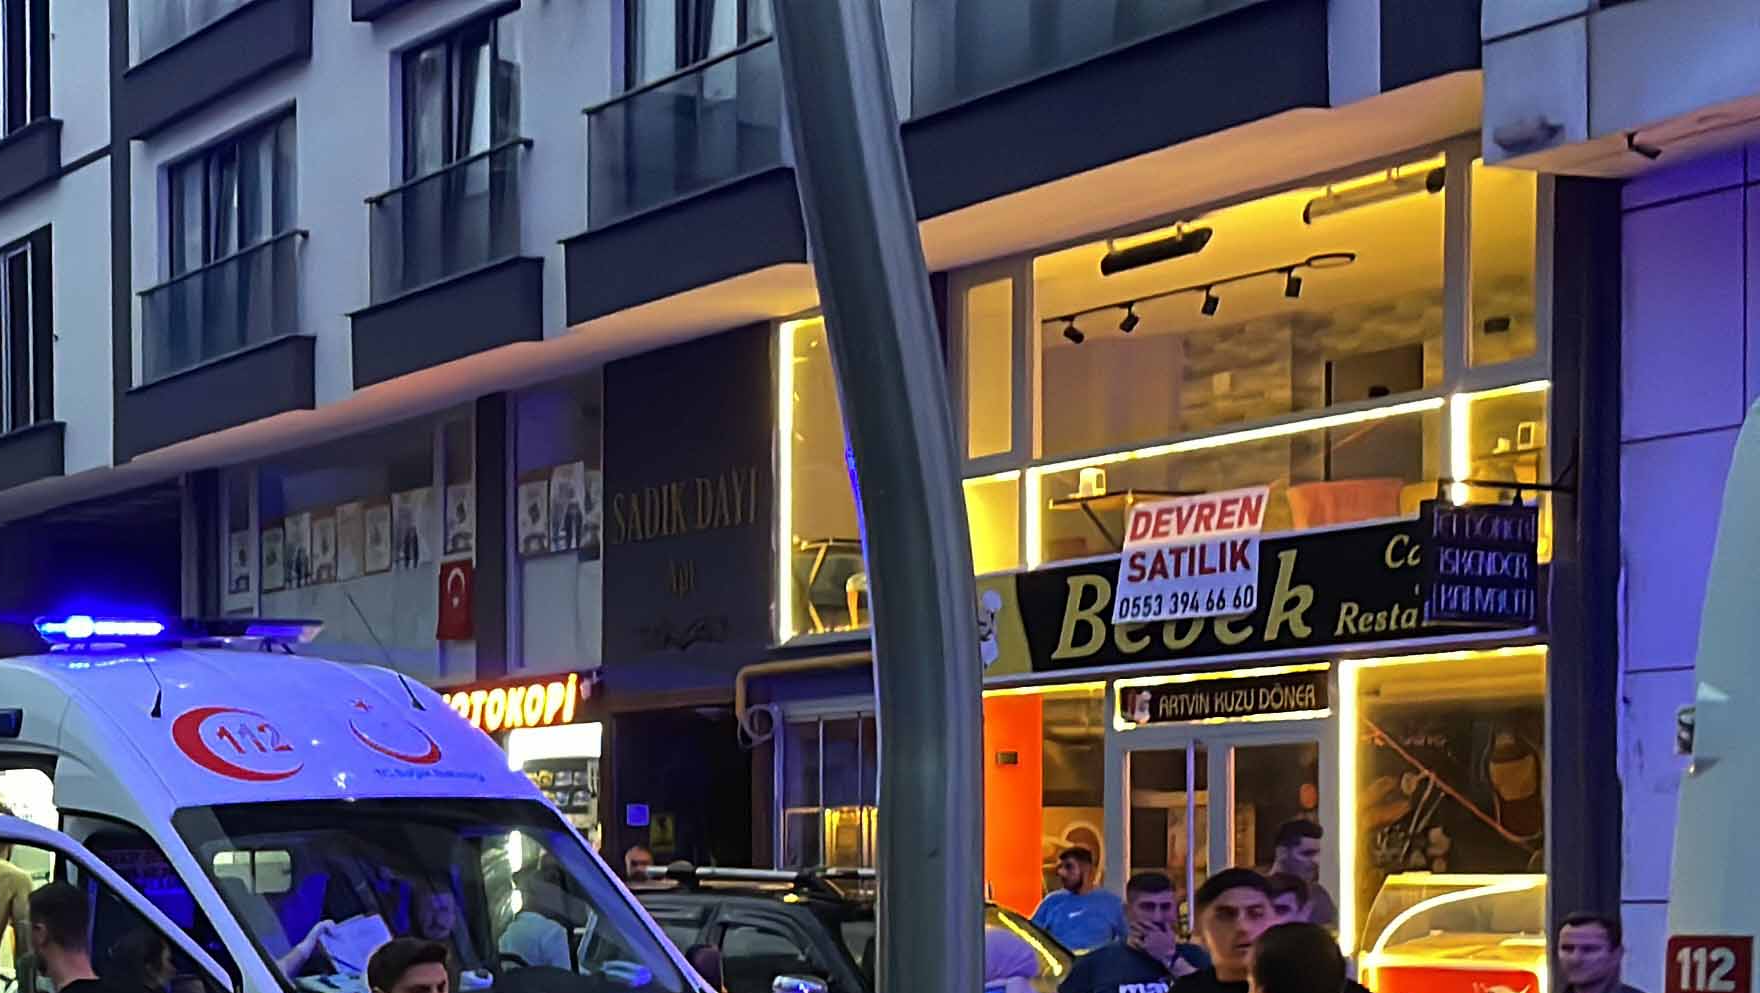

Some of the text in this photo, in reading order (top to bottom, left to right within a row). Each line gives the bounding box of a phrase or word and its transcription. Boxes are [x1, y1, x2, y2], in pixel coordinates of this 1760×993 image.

[1129, 494, 1264, 542] DEVREN
[1127, 538, 1252, 583] SATILIK
[1119, 584, 1254, 619] 0553 394 66 60
[1334, 601, 1419, 636] Resta
[442, 672, 578, 732] OTOKOPİ
[1215, 688, 1255, 712] KUZU
[216, 723, 295, 755] 112
[1676, 946, 1737, 992] 112
